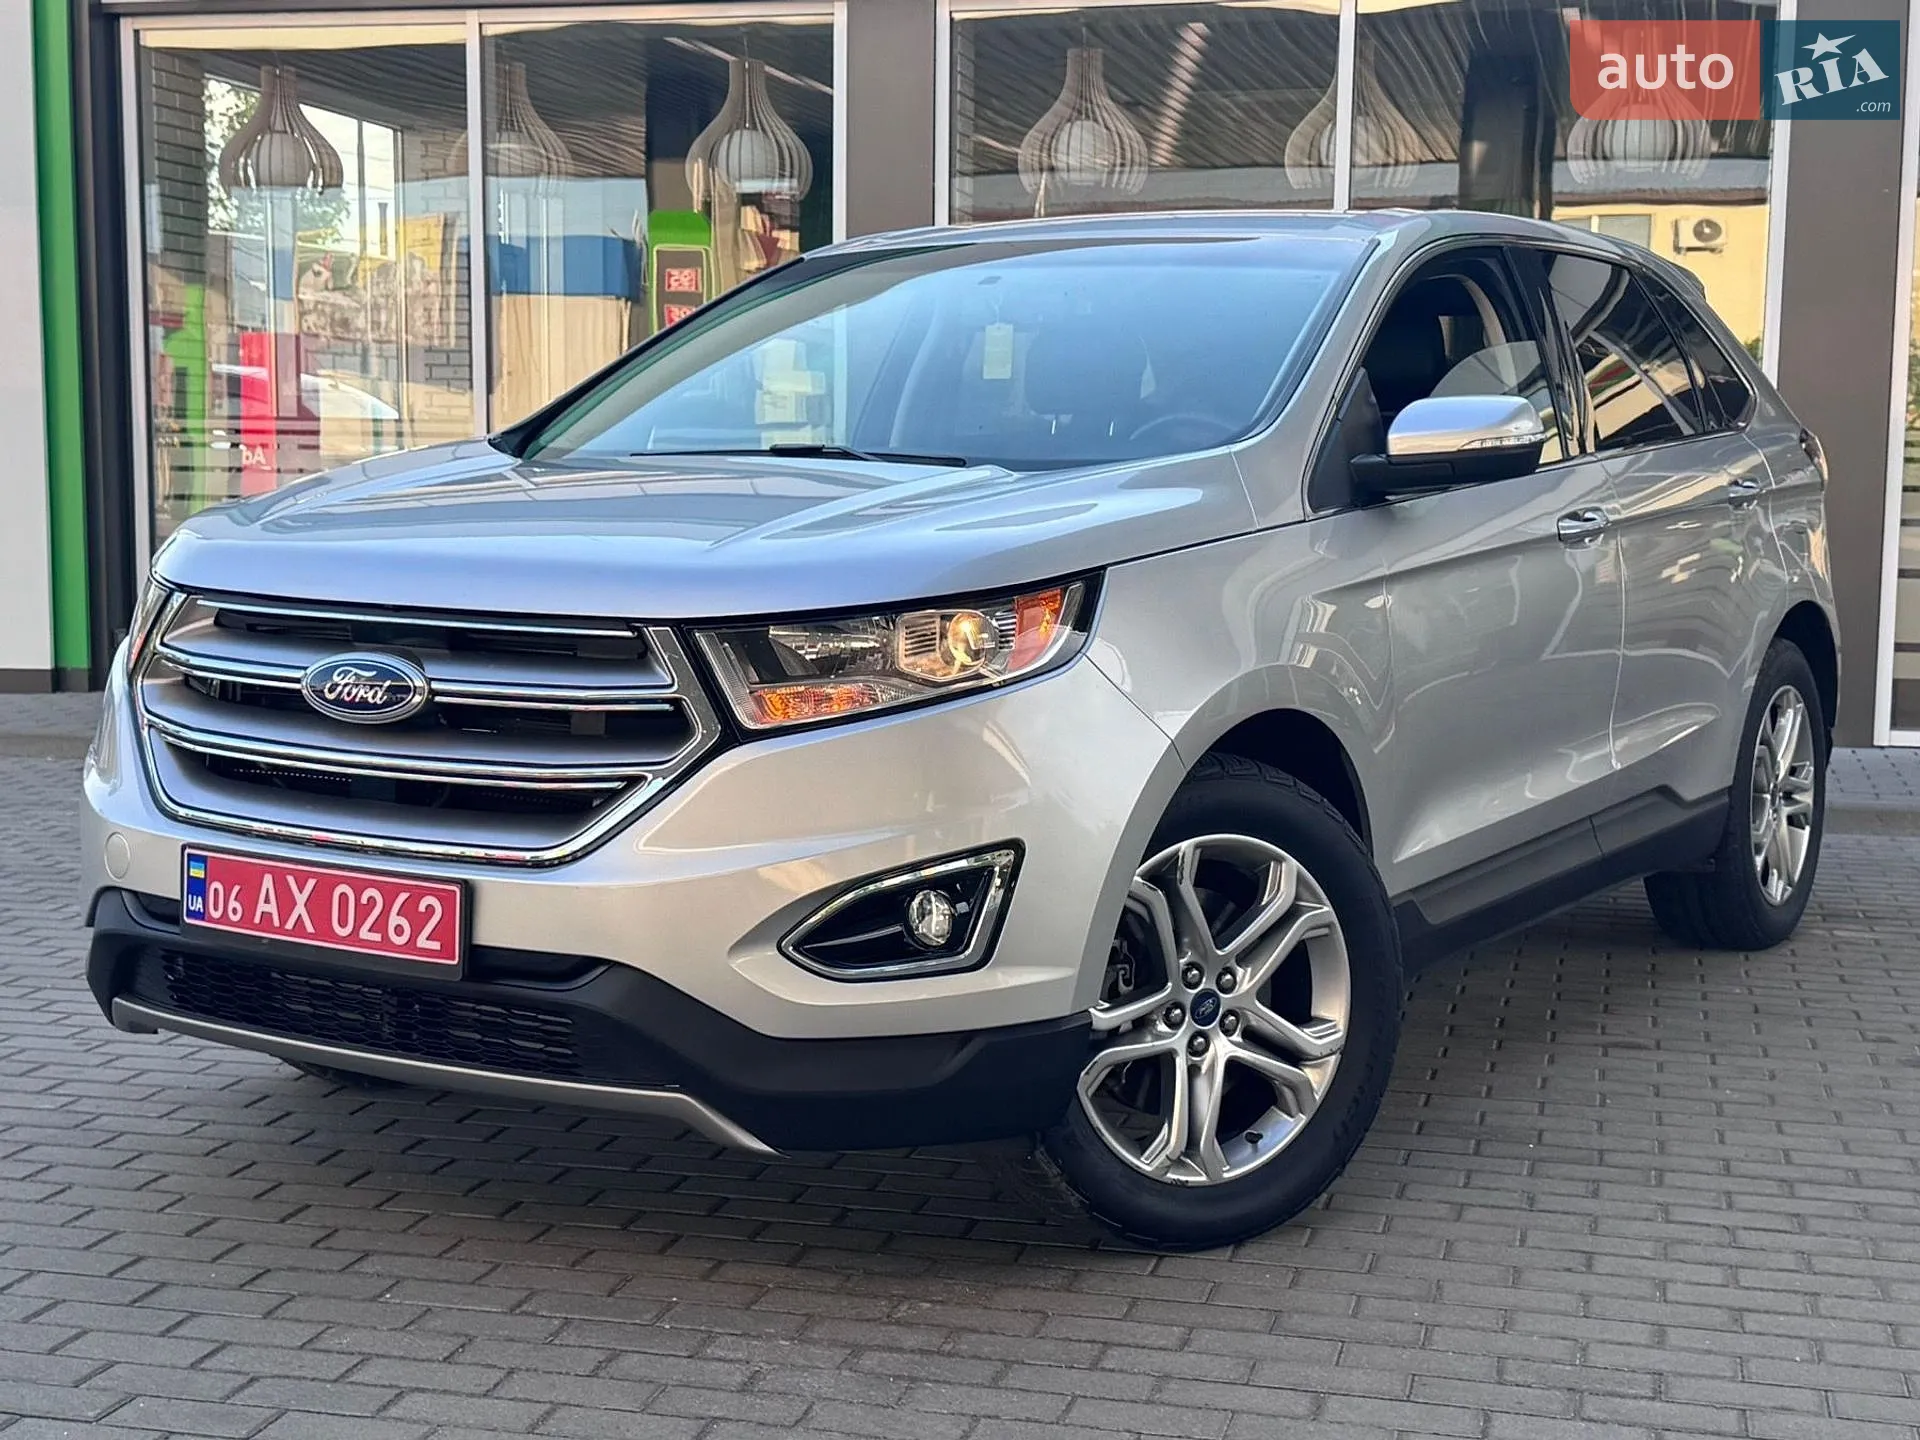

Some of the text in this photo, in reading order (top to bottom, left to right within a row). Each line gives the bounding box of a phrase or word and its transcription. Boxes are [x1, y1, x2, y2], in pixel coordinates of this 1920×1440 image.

[324, 666, 391, 704] Ford
[188, 894, 204, 913] UA
[208, 873, 443, 951] 06 AX 0262
